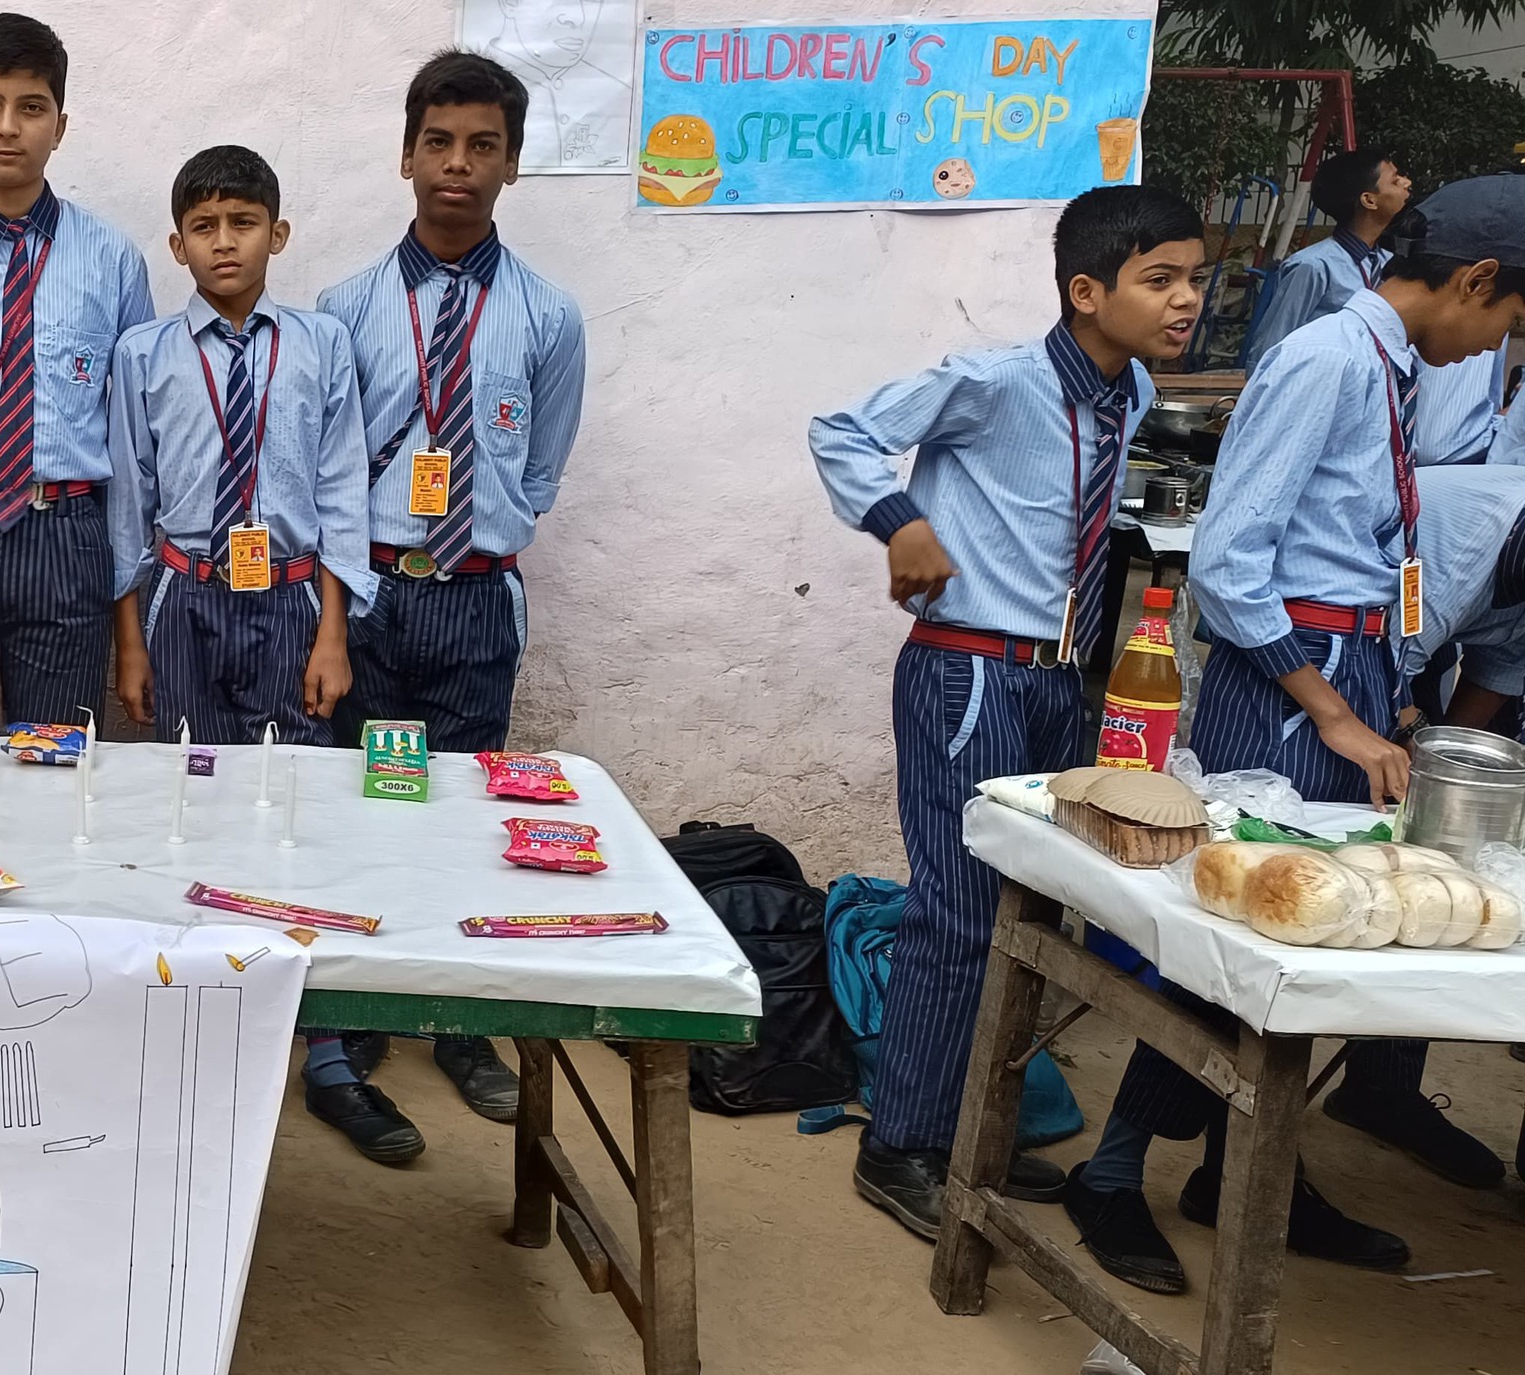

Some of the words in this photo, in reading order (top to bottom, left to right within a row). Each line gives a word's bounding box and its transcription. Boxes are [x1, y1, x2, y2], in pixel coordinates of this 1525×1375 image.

[660, 28, 946, 87] CHILDREN'S
[992, 35, 1079, 87] DAY
[726, 102, 898, 165] SPECIAL
[915, 89, 1070, 148] SHOP
[381, 781, 414, 792] 300X6
[506, 915, 572, 925] CRUNCHY
